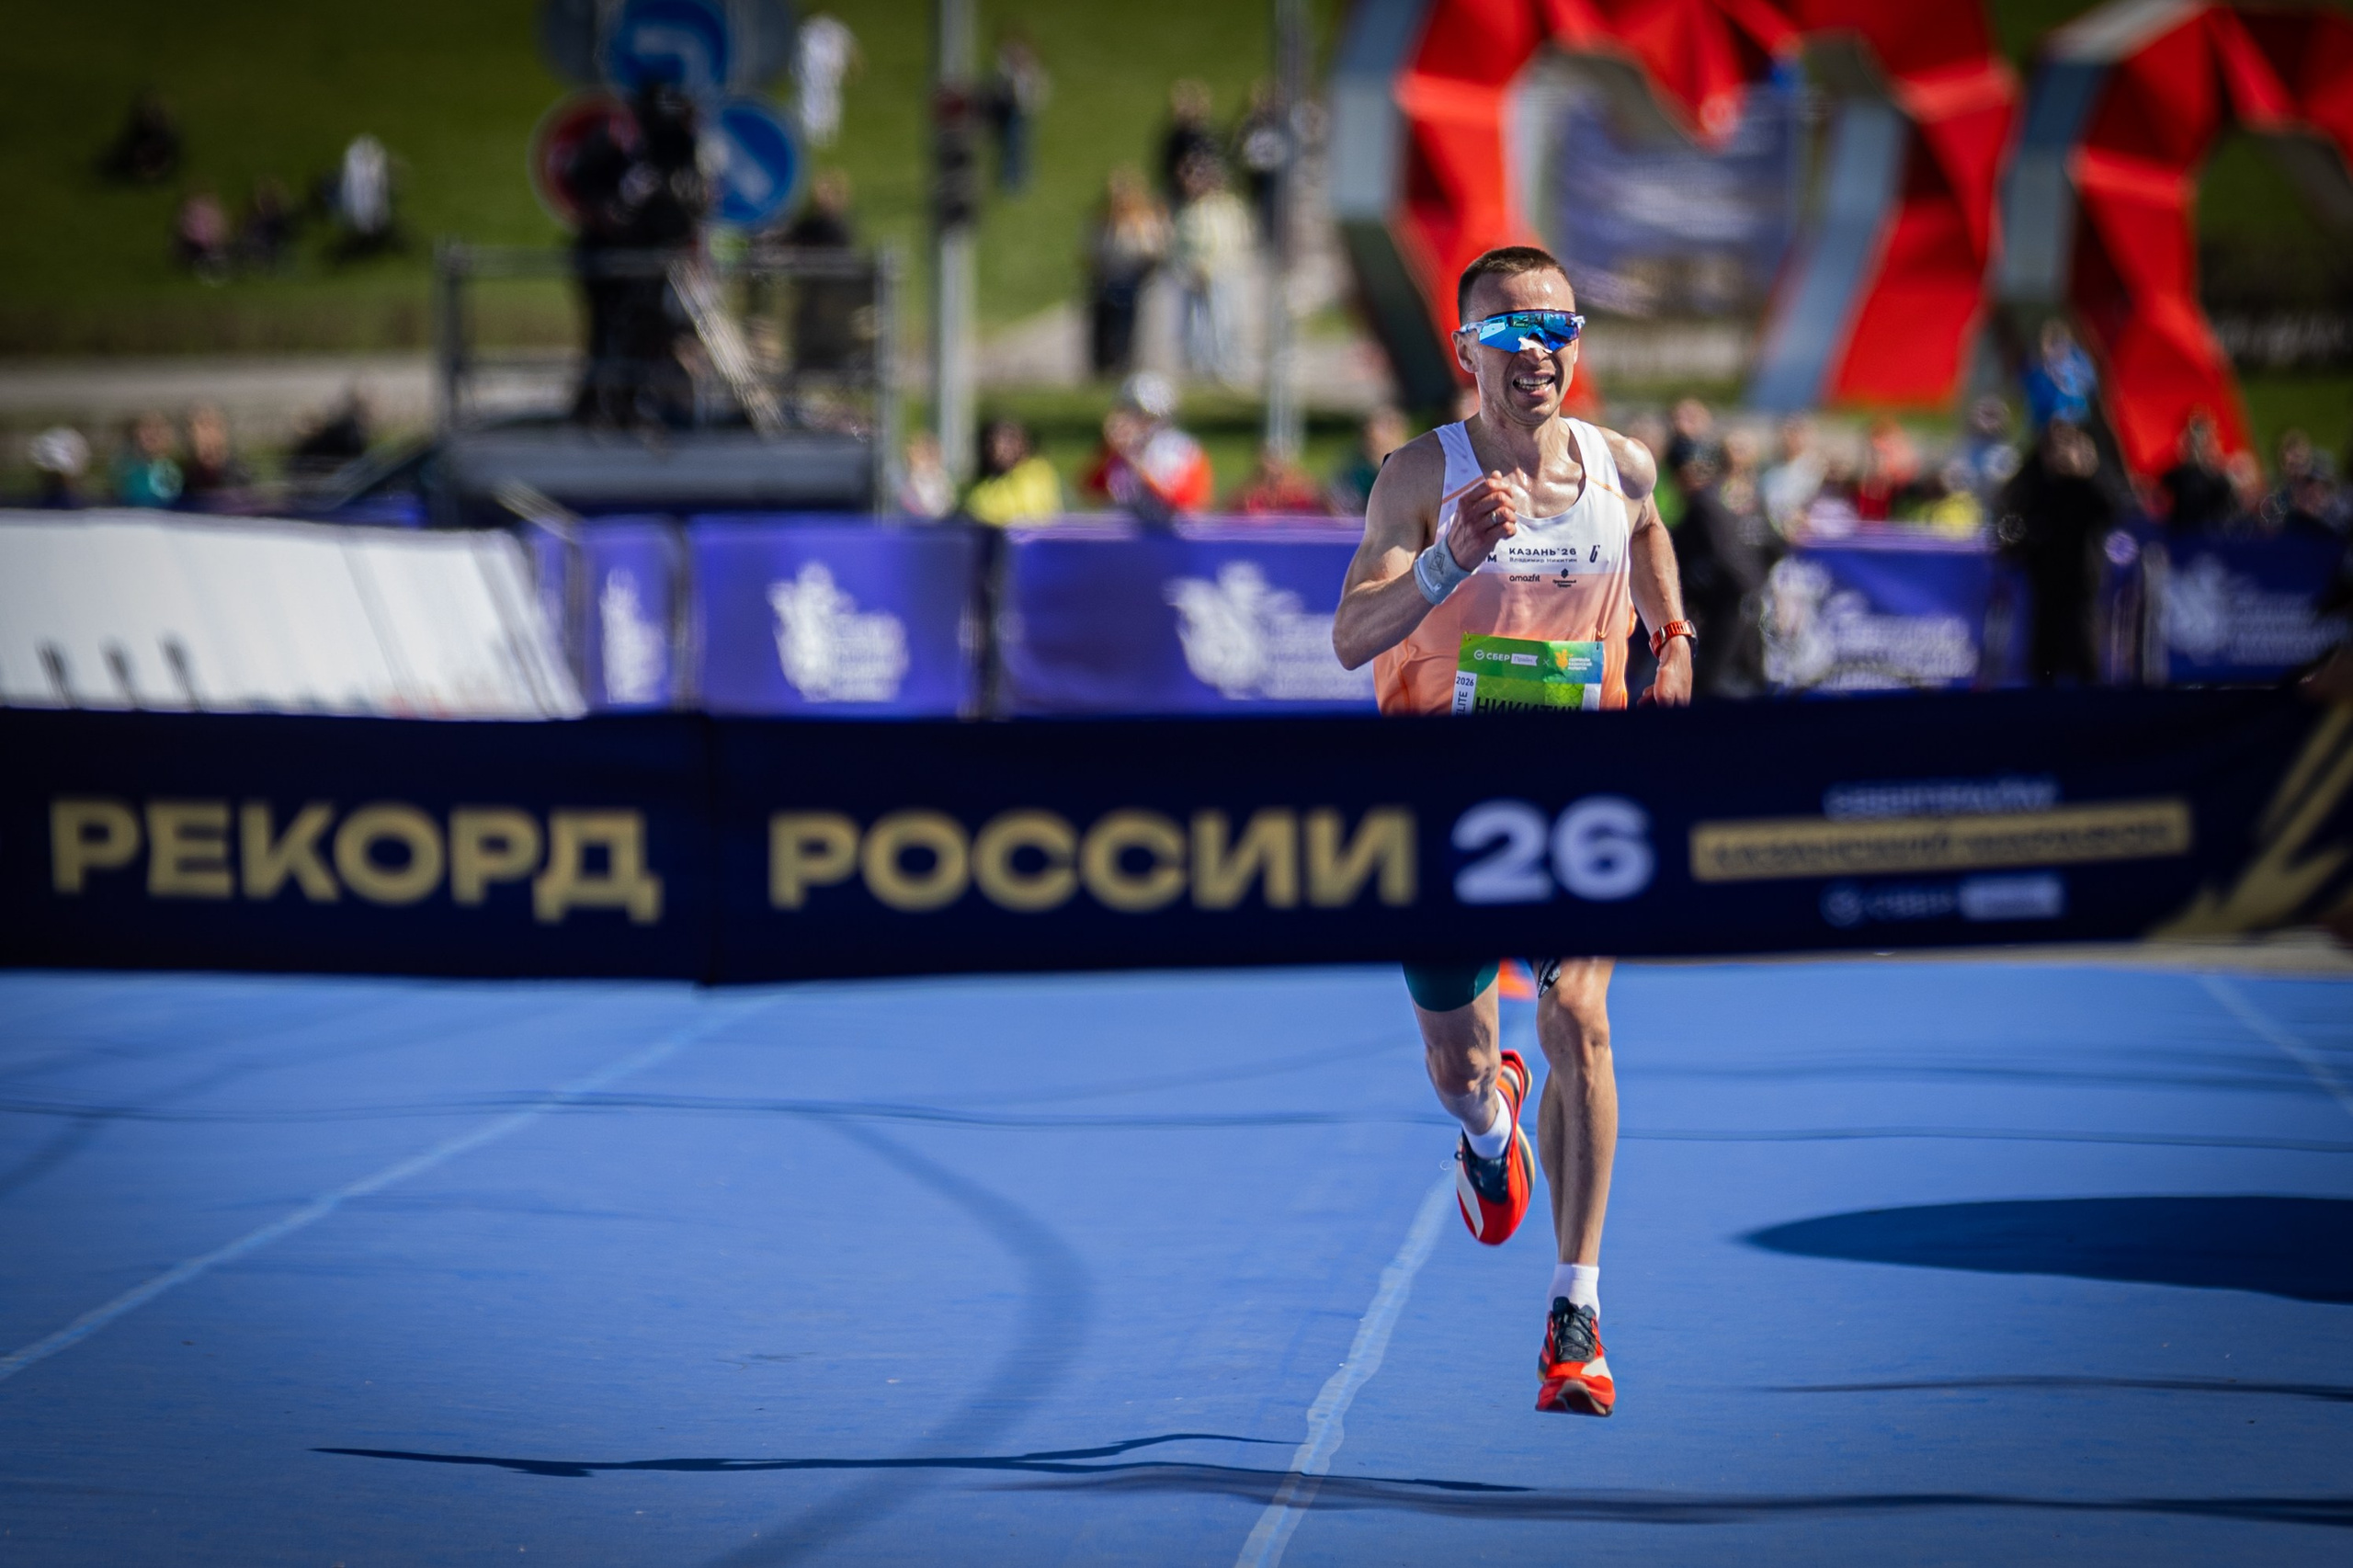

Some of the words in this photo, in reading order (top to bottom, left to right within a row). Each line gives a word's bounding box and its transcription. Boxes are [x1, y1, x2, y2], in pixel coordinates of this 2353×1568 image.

[1509, 574, 1540, 582] amazfit
[1486, 652, 1510, 661] СБЕР
[1456, 676, 1474, 687] 2026
[51, 798, 661, 922] РЕКОРД
[769, 808, 1415, 912] РОССИИ
[1452, 796, 1654, 903] 26
